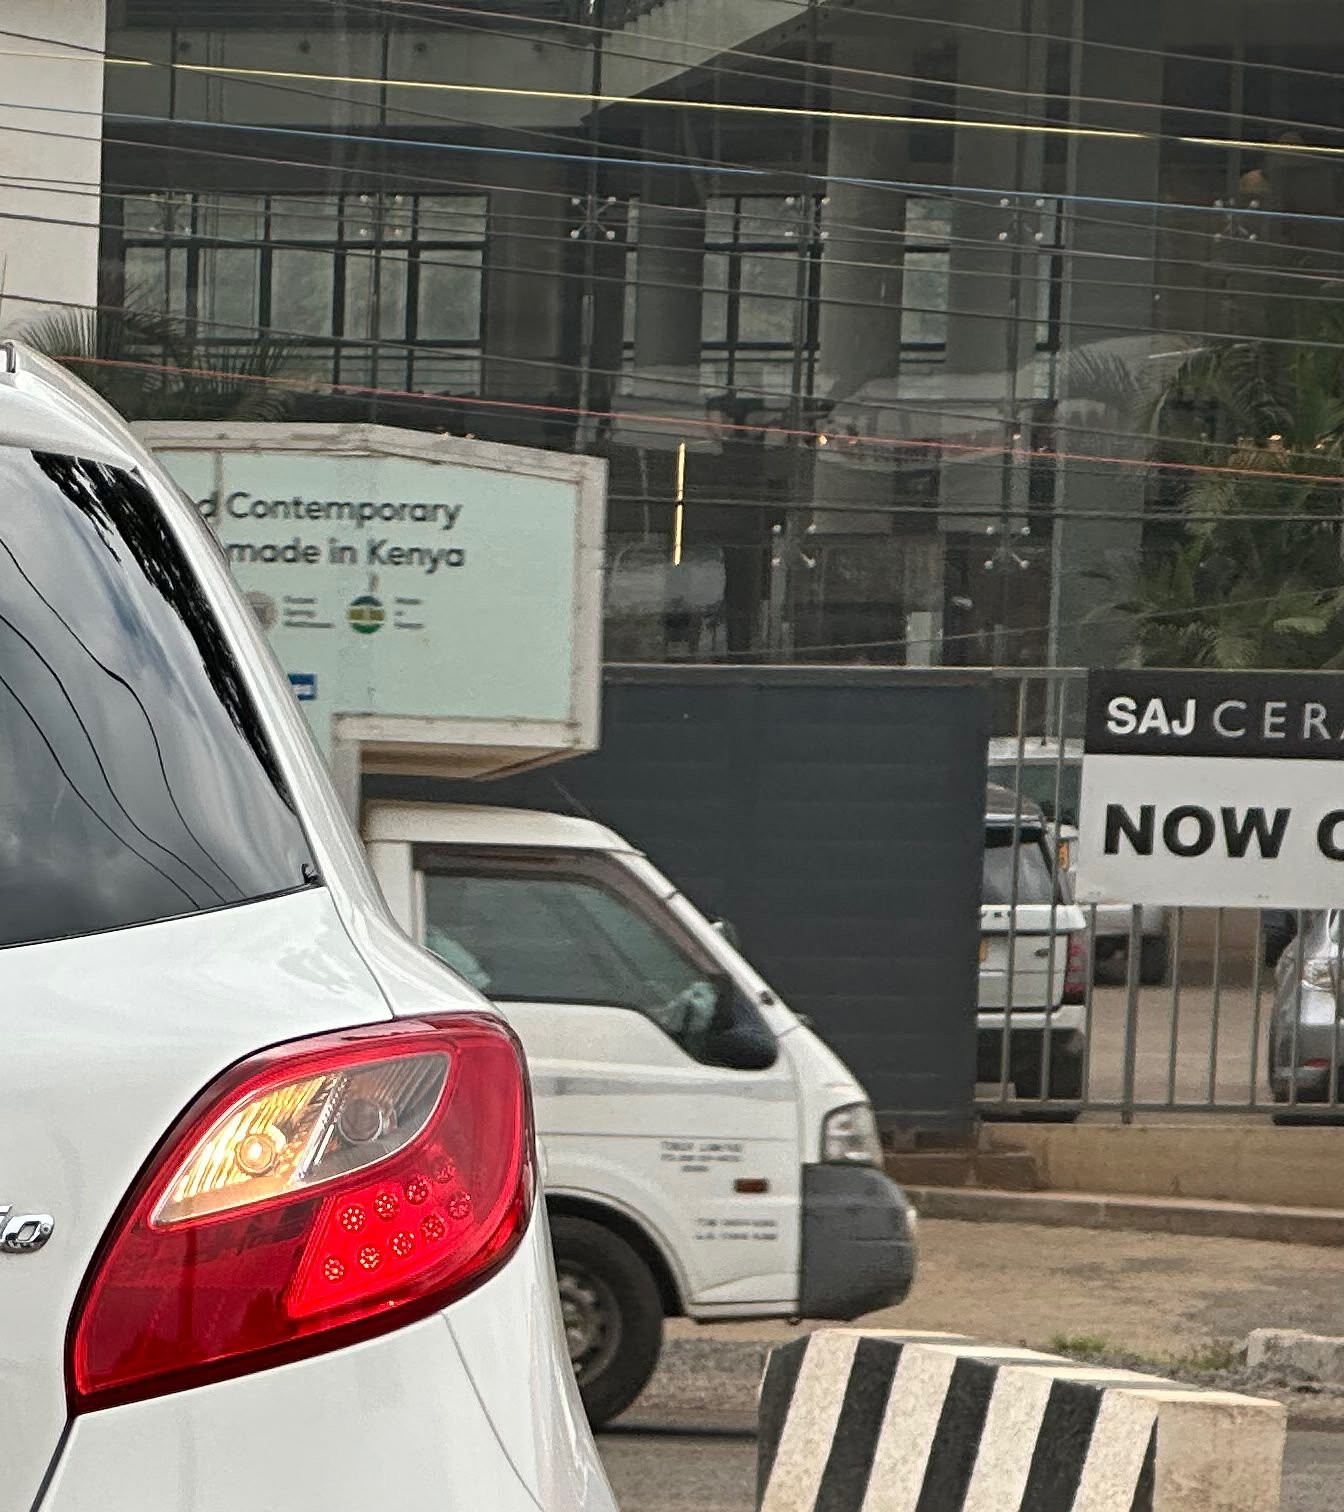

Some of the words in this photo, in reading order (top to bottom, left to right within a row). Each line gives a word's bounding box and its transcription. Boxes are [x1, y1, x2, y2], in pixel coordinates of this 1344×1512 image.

[226, 491, 463, 530] Contemporary
[328, 537, 358, 565] in
[368, 538, 465, 574] Kenya
[1107, 697, 1196, 736] SAJ
[1214, 700, 1344, 740] CER
[1104, 803, 1292, 859] NOW
